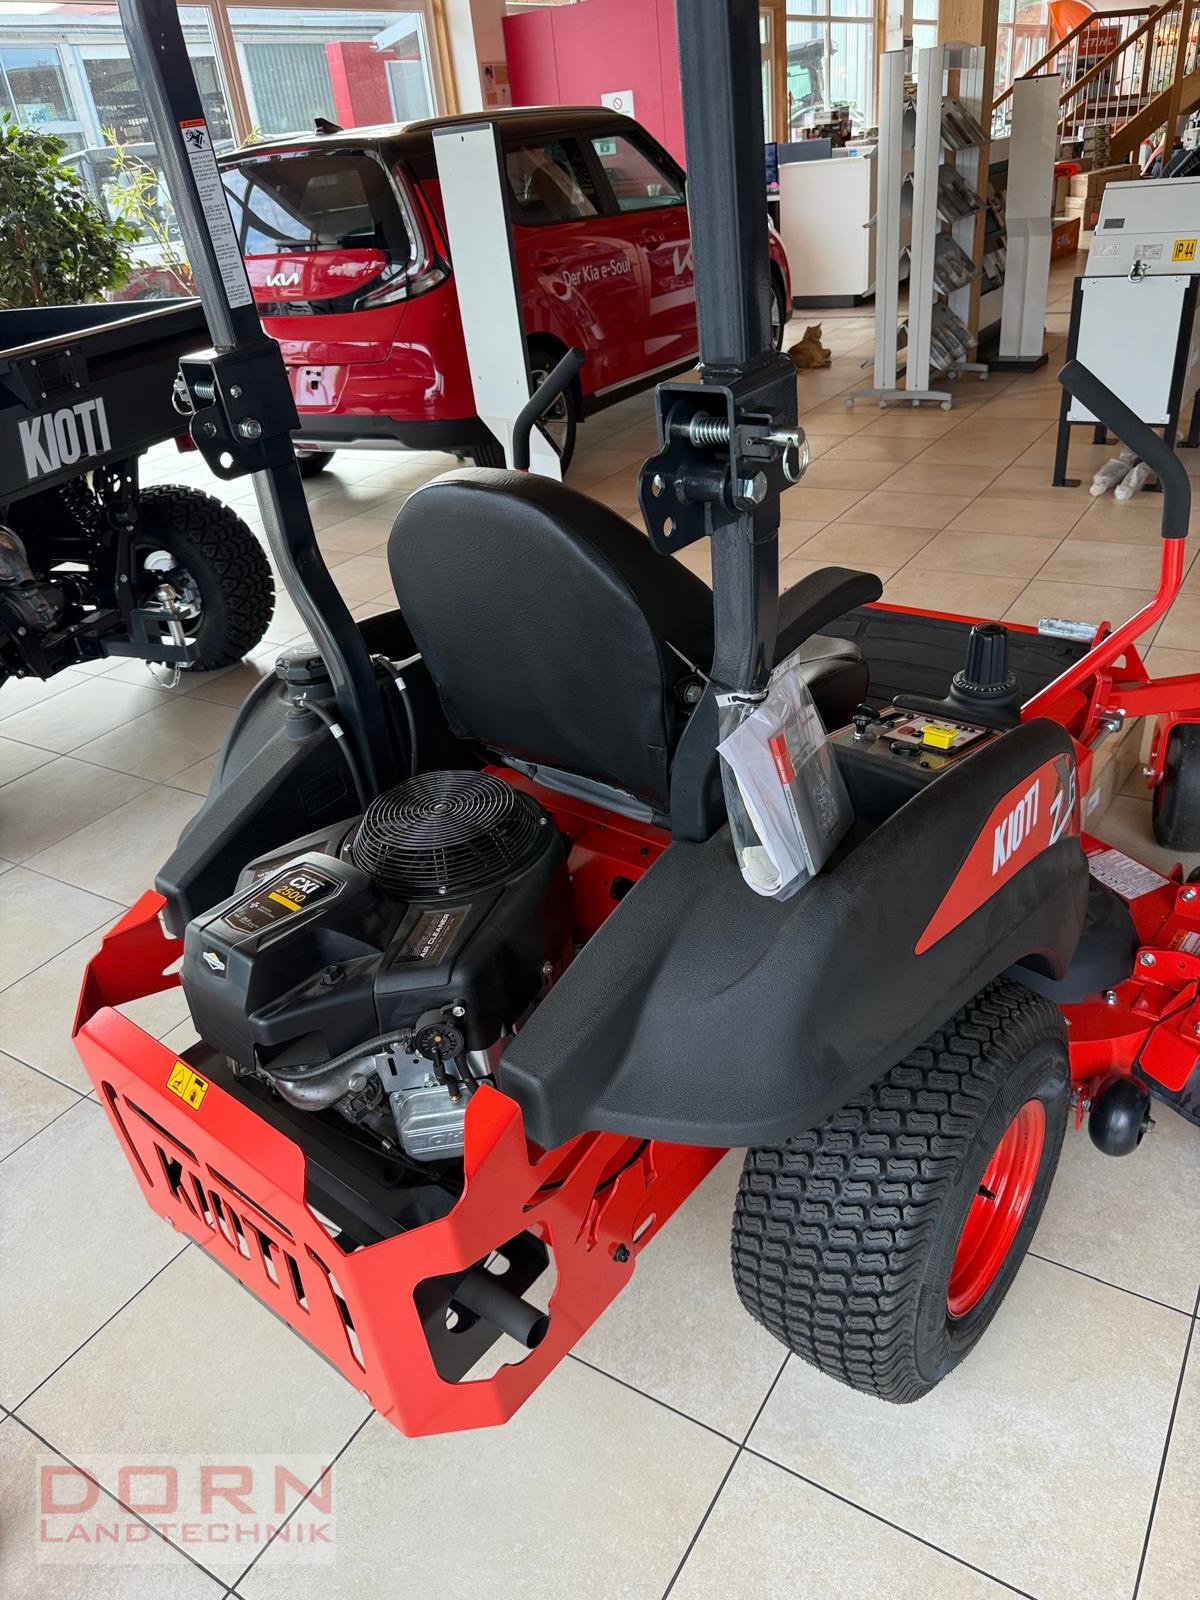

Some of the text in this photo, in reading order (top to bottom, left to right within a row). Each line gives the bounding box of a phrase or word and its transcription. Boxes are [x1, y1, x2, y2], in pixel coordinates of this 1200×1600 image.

[562, 256, 631, 287] Der Kia e-Soul
[1174, 243, 1184, 258] IP
[1184, 242, 1195, 258] 44
[18, 397, 112, 479] KIOTI
[992, 778, 1040, 876] KIOTI
[275, 885, 306, 903] 2500
[420, 945, 431, 958] AIR
[427, 913, 451, 945] CLEANER
[153, 1141, 311, 1316] KIOTI
